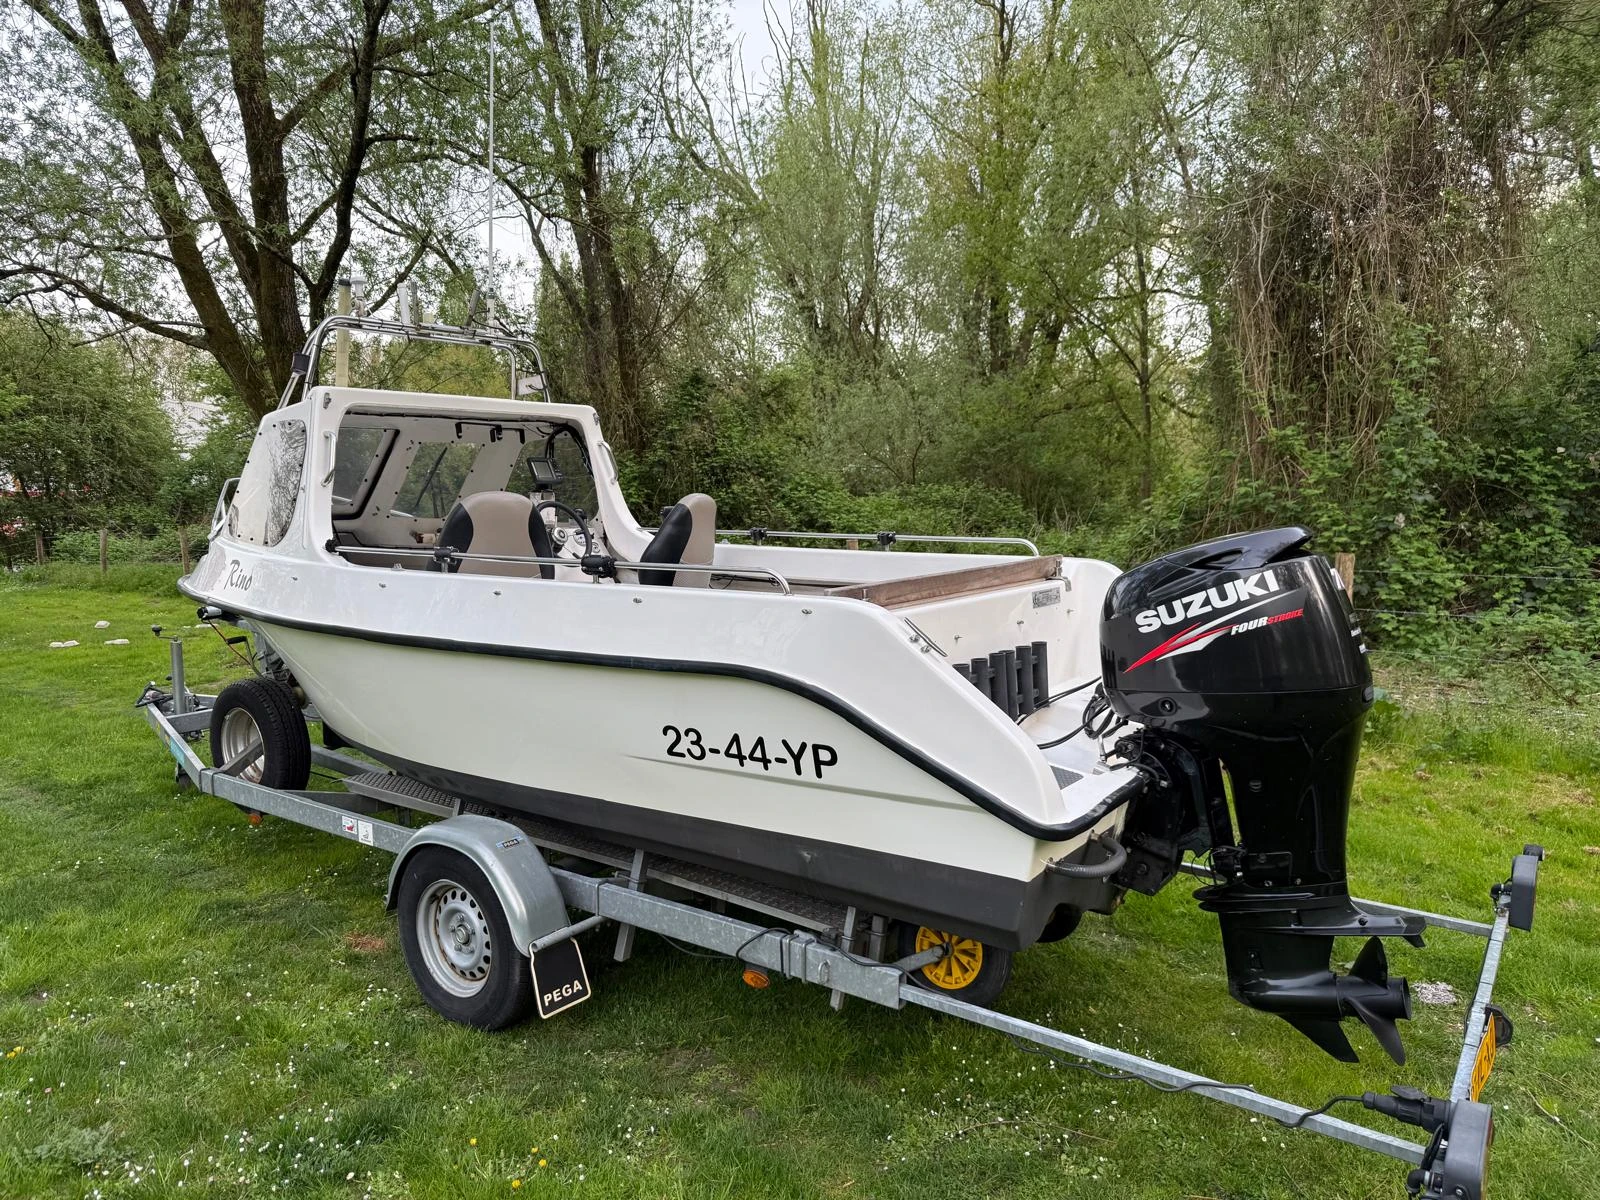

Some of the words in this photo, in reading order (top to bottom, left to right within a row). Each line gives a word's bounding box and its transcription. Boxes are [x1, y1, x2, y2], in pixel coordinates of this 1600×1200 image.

[1135, 569, 1280, 634] SUZUKI
[662, 725, 838, 779] 23-44-YP
[543, 979, 583, 1007] PEGA
